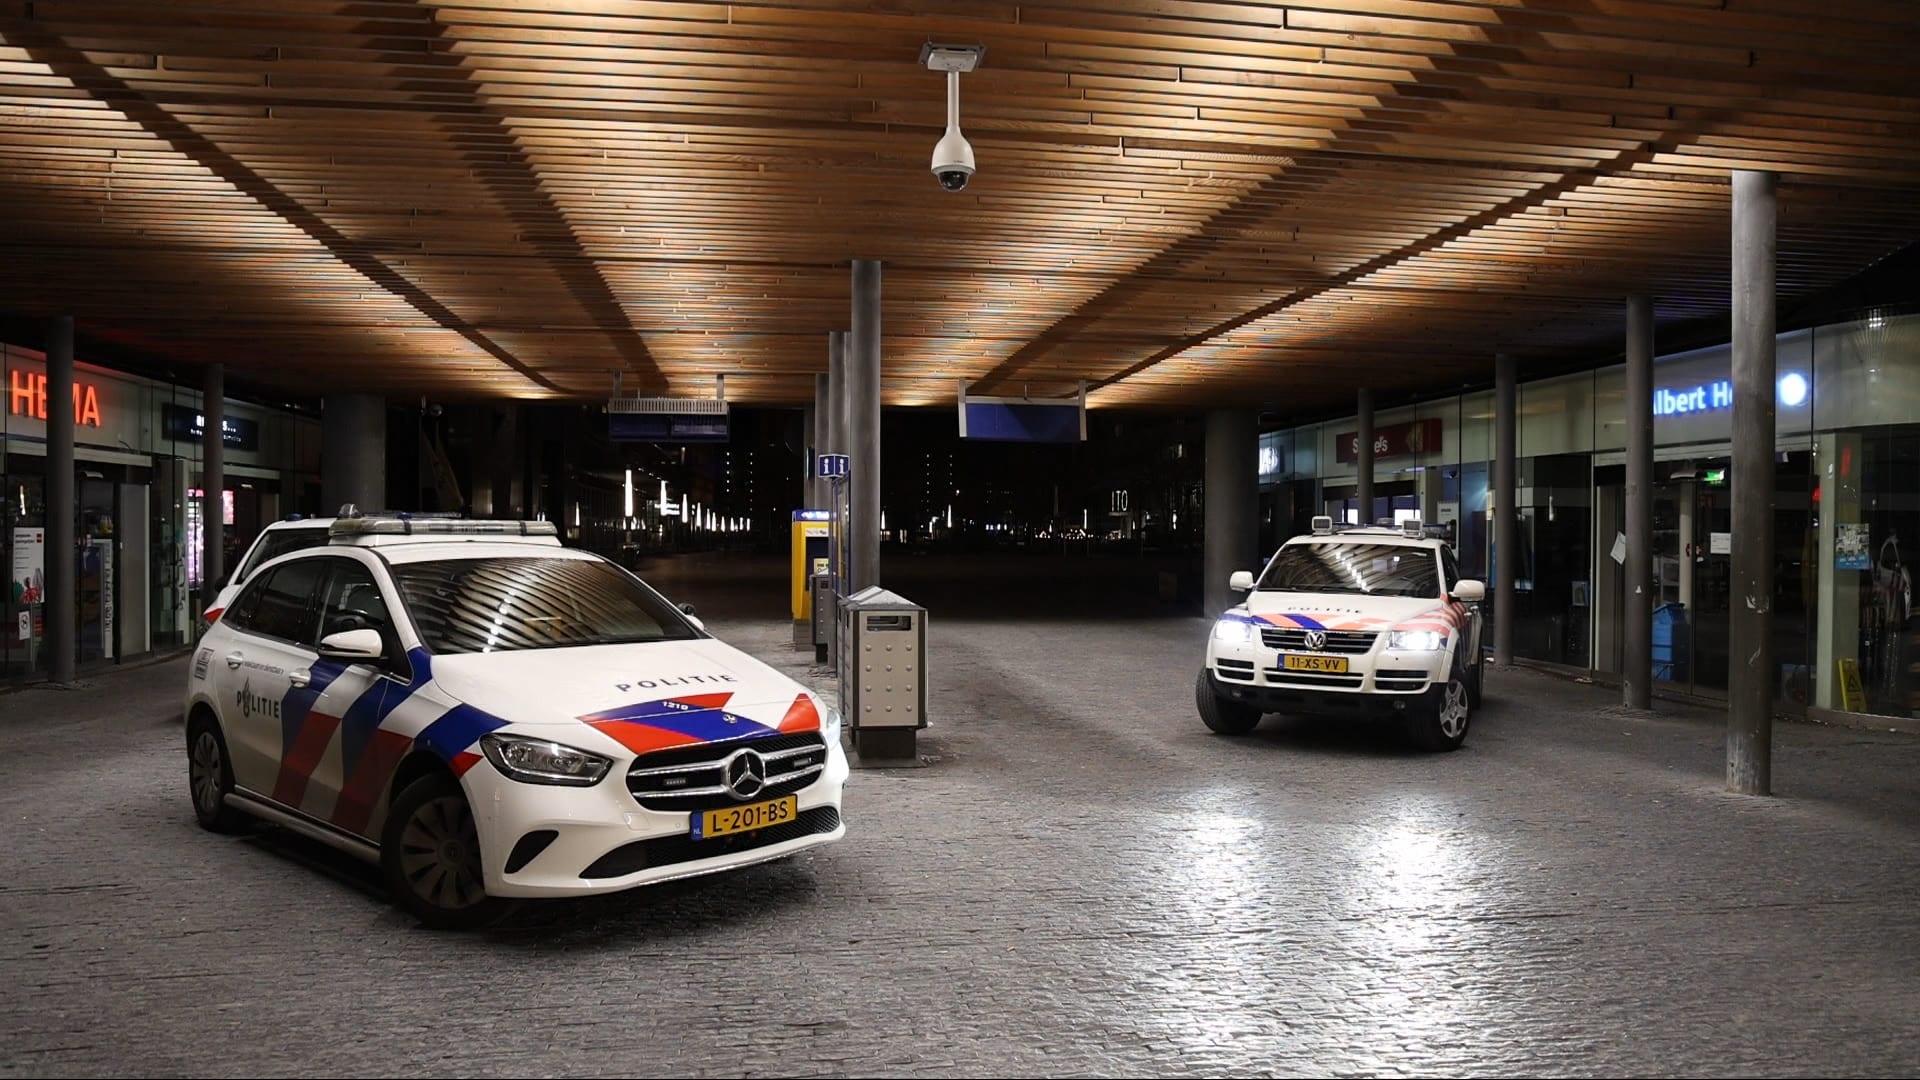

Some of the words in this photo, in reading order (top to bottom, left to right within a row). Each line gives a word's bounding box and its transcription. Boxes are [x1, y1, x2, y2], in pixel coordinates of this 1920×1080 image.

[12, 369, 100, 427] HEA
[1653, 385, 1706, 415] lbert
[1291, 657, 1340, 670] 11-XS-VV
[614, 674, 738, 692] POLITIE
[712, 800, 788, 833] L-201-BS
